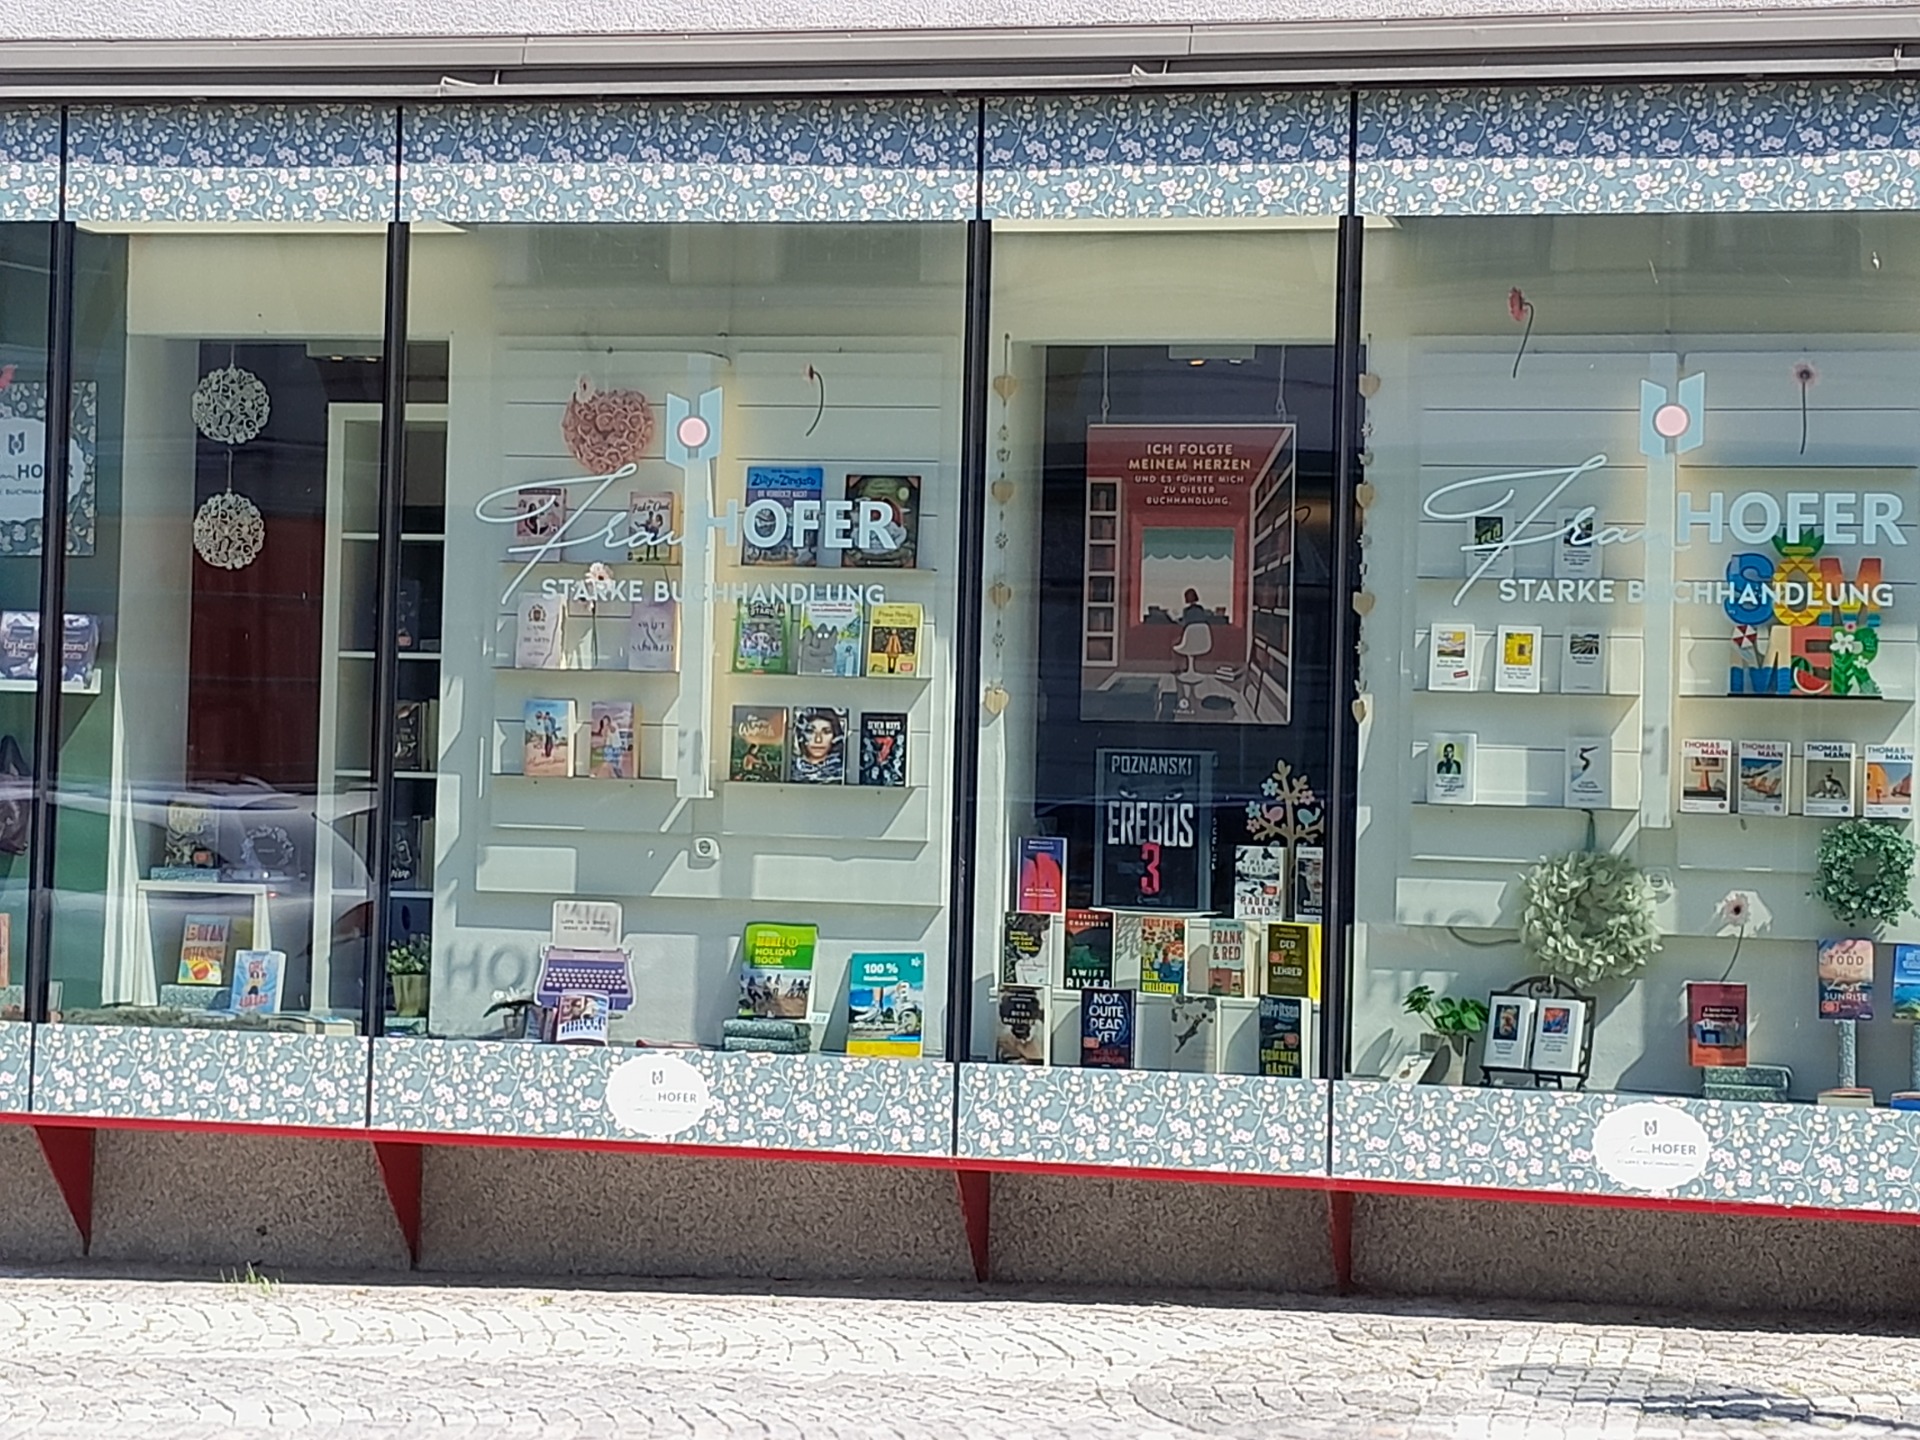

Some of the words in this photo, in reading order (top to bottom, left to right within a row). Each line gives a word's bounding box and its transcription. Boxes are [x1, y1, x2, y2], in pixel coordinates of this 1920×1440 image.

[1147, 444, 1173, 455] ICH
[1179, 444, 1233, 456] FOLGTE
[1128, 459, 1188, 471] MEINEM
[1193, 459, 1251, 471] HERZEN
[1135, 475, 1157, 483] UND
[1160, 475, 1172, 483] ES
[1176, 474, 1214, 483] FÜHRTE
[1218, 475, 1244, 483] MICH
[1163, 485, 1176, 494] ZU
[1180, 485, 1215, 494] DIESER
[1146, 496, 1232, 505] BUCHHANDLUNG.
[704, 498, 897, 550] HOFER
[1423, 454, 1692, 606] Fra
[1677, 492, 1907, 545] HOFER
[541, 578, 644, 602] STARKE
[1499, 579, 1615, 602] STARKE
[1627, 580, 1894, 607] BCHHANDLUNG
[1684, 742, 1720, 750] THOMAS
[1741, 743, 1776, 751] THOMAS
[1807, 744, 1843, 752] THOMAS
[1867, 746, 1905, 754] THOMAS
[1111, 755, 1192, 776] POZNANSKI
[1107, 801, 1194, 847] EREBOS
[1140, 842, 1161, 895] 3
[1245, 906, 1271, 916] LAND
[1212, 929, 1243, 945] FRANK
[755, 948, 797, 957] HOLIDAY
[1222, 946, 1241, 961] RED
[754, 956, 783, 965] BOOK
[1828, 955, 1864, 966] TODD
[863, 963, 885, 975] 100
[886, 963, 899, 975] %
[1072, 968, 1105, 977] SWIFT
[1066, 978, 1110, 989] RIVER
[1094, 993, 1119, 1005] NOT
[1824, 992, 1868, 1002] SUNRISE
[1089, 1005, 1124, 1018] QUITE
[1090, 1018, 1122, 1030] DEAD
[1095, 1030, 1117, 1042] YET
[658, 1092, 697, 1104] HOFER
[1652, 1144, 1697, 1156] HOFER
